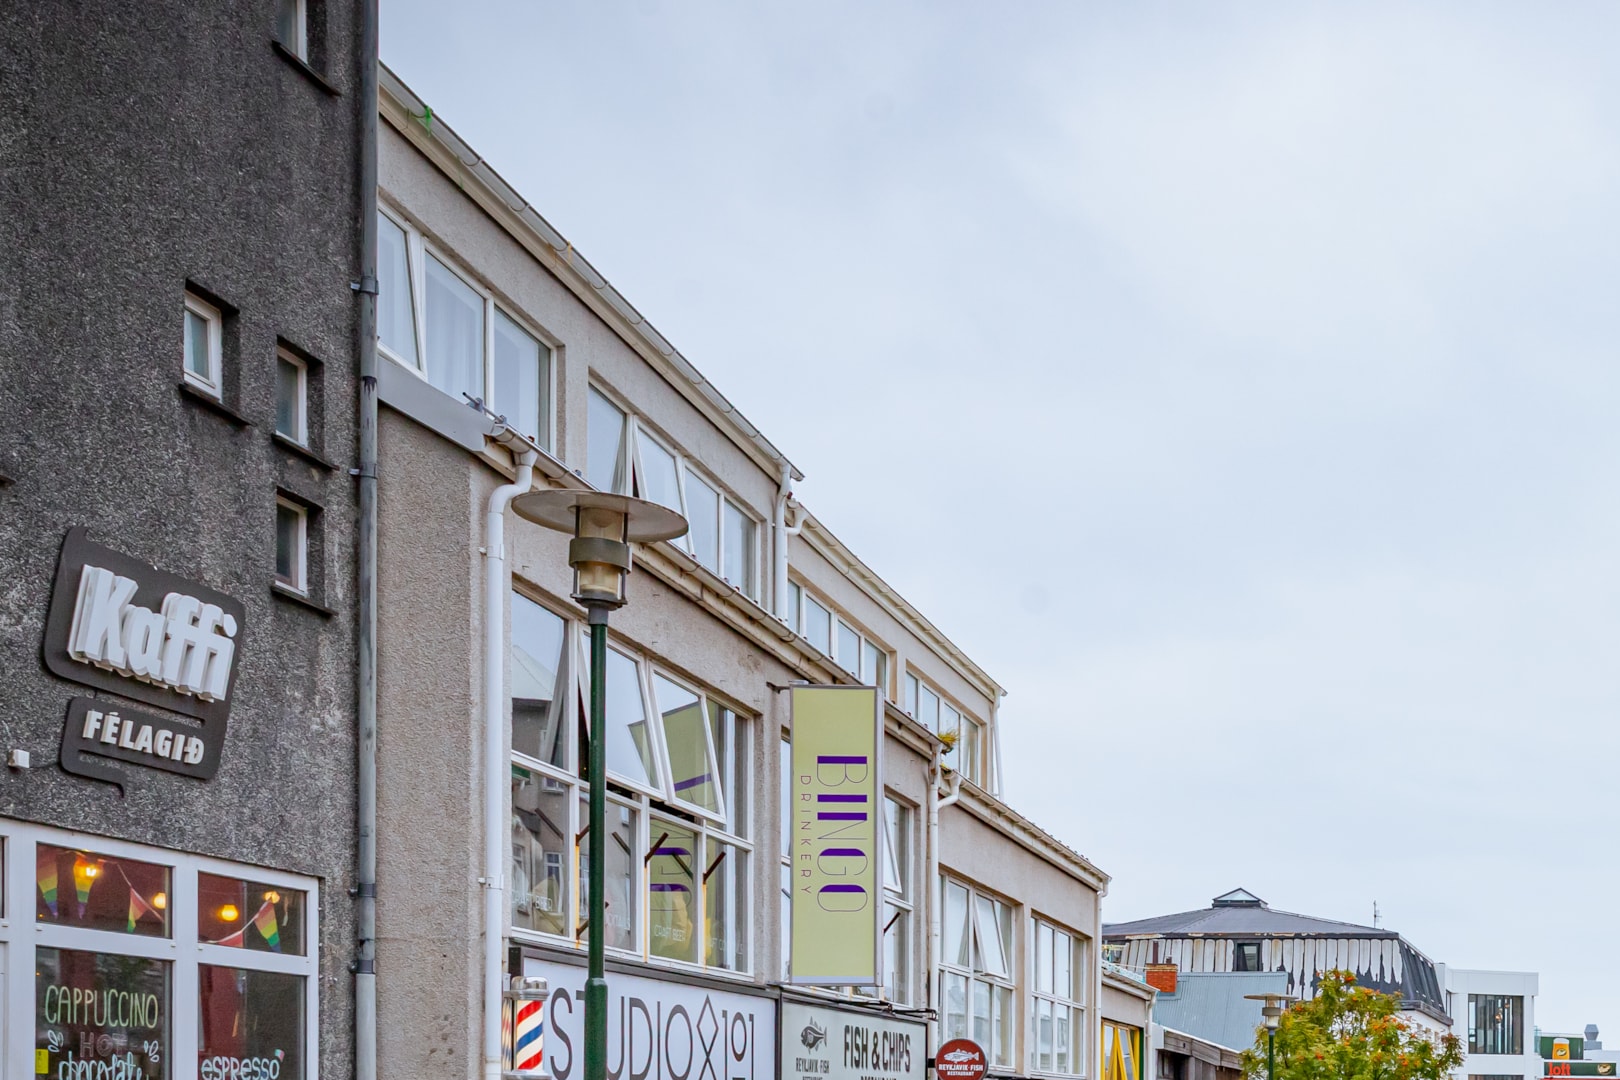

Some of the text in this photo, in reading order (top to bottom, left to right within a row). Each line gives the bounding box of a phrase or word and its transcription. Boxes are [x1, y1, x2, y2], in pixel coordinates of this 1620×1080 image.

[68, 564, 237, 702] Kaffi
[82, 710, 205, 766] FÉLAGIÐ
[800, 775, 811, 894] DRINKERY
[817, 755, 868, 912] BINGO
[45, 985, 158, 1029] CAPPUCCINO
[844, 1024, 911, 1073] FISH & CHIPS
